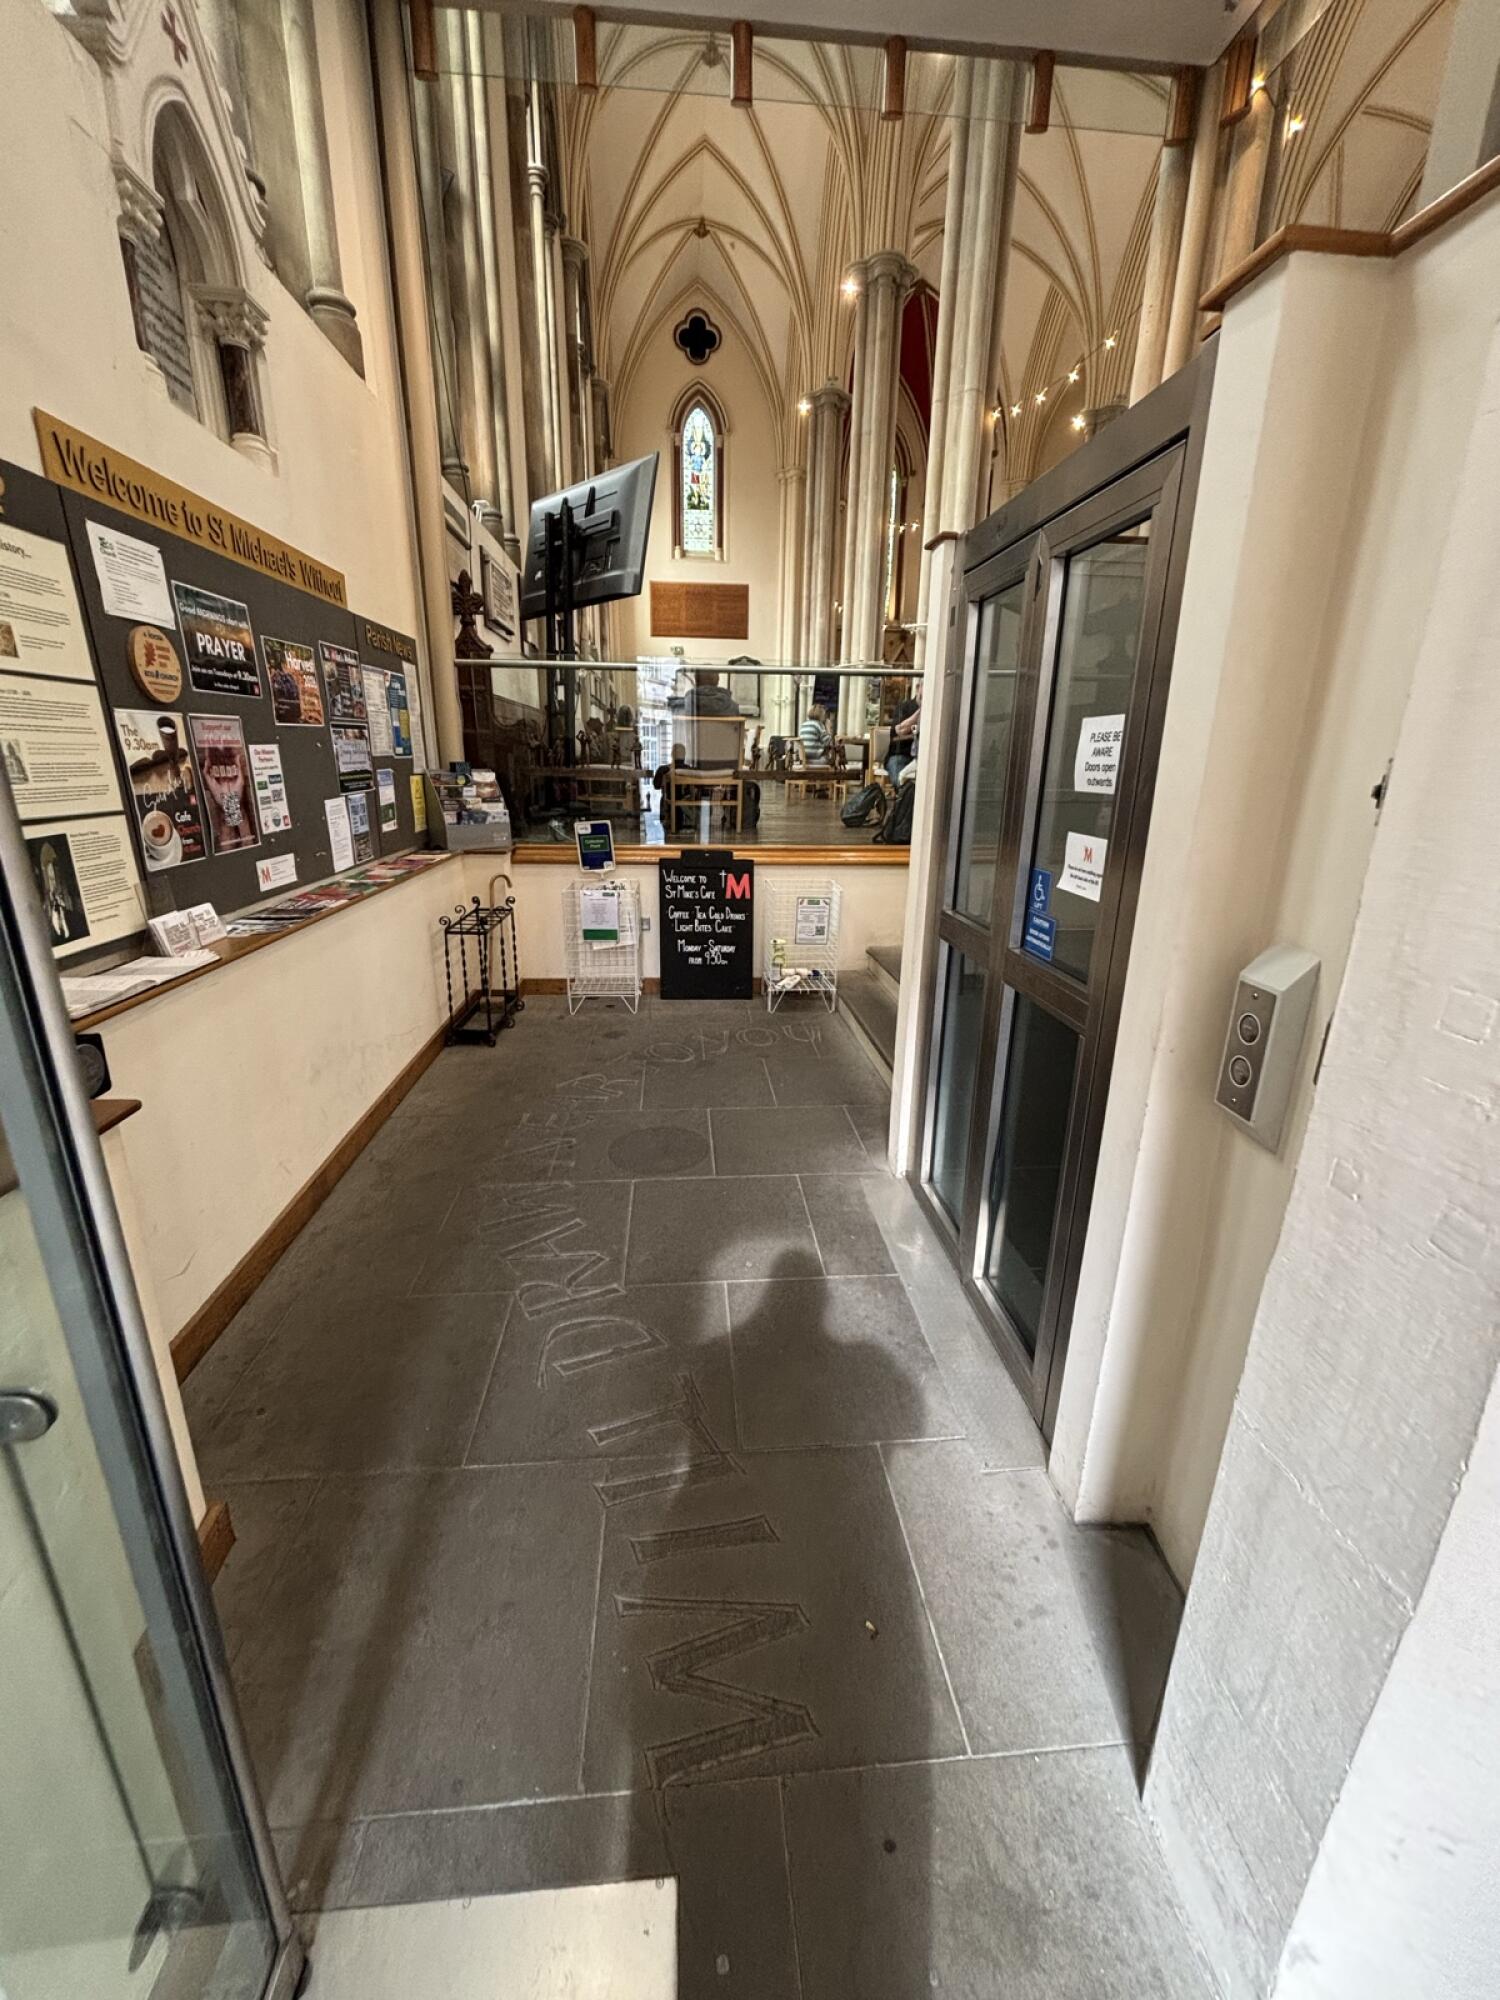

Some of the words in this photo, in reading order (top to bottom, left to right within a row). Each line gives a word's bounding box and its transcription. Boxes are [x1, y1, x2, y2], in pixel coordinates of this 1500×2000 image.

[51, 431, 180, 527] Welcome
[181, 501, 203, 538] to
[206, 515, 228, 551] St
[229, 523, 298, 582] Michael's
[195, 632, 247, 662] PRAYER
[365, 624, 393, 653] Parish
[120, 724, 139, 737] The
[1089, 731, 1112, 743] PLEASE
[1112, 730, 1122, 742] BE
[125, 737, 160, 752] 9.30am
[1091, 746, 1113, 758] AWARE
[1084, 761, 1101, 773] Doors
[1101, 762, 1116, 774] open
[1083, 846, 1093, 864] M
[260, 866, 272, 885] M
[662, 869, 697, 884] WELCOME
[725, 873, 751, 900] M
[587, 1372, 822, 1800] WILL
